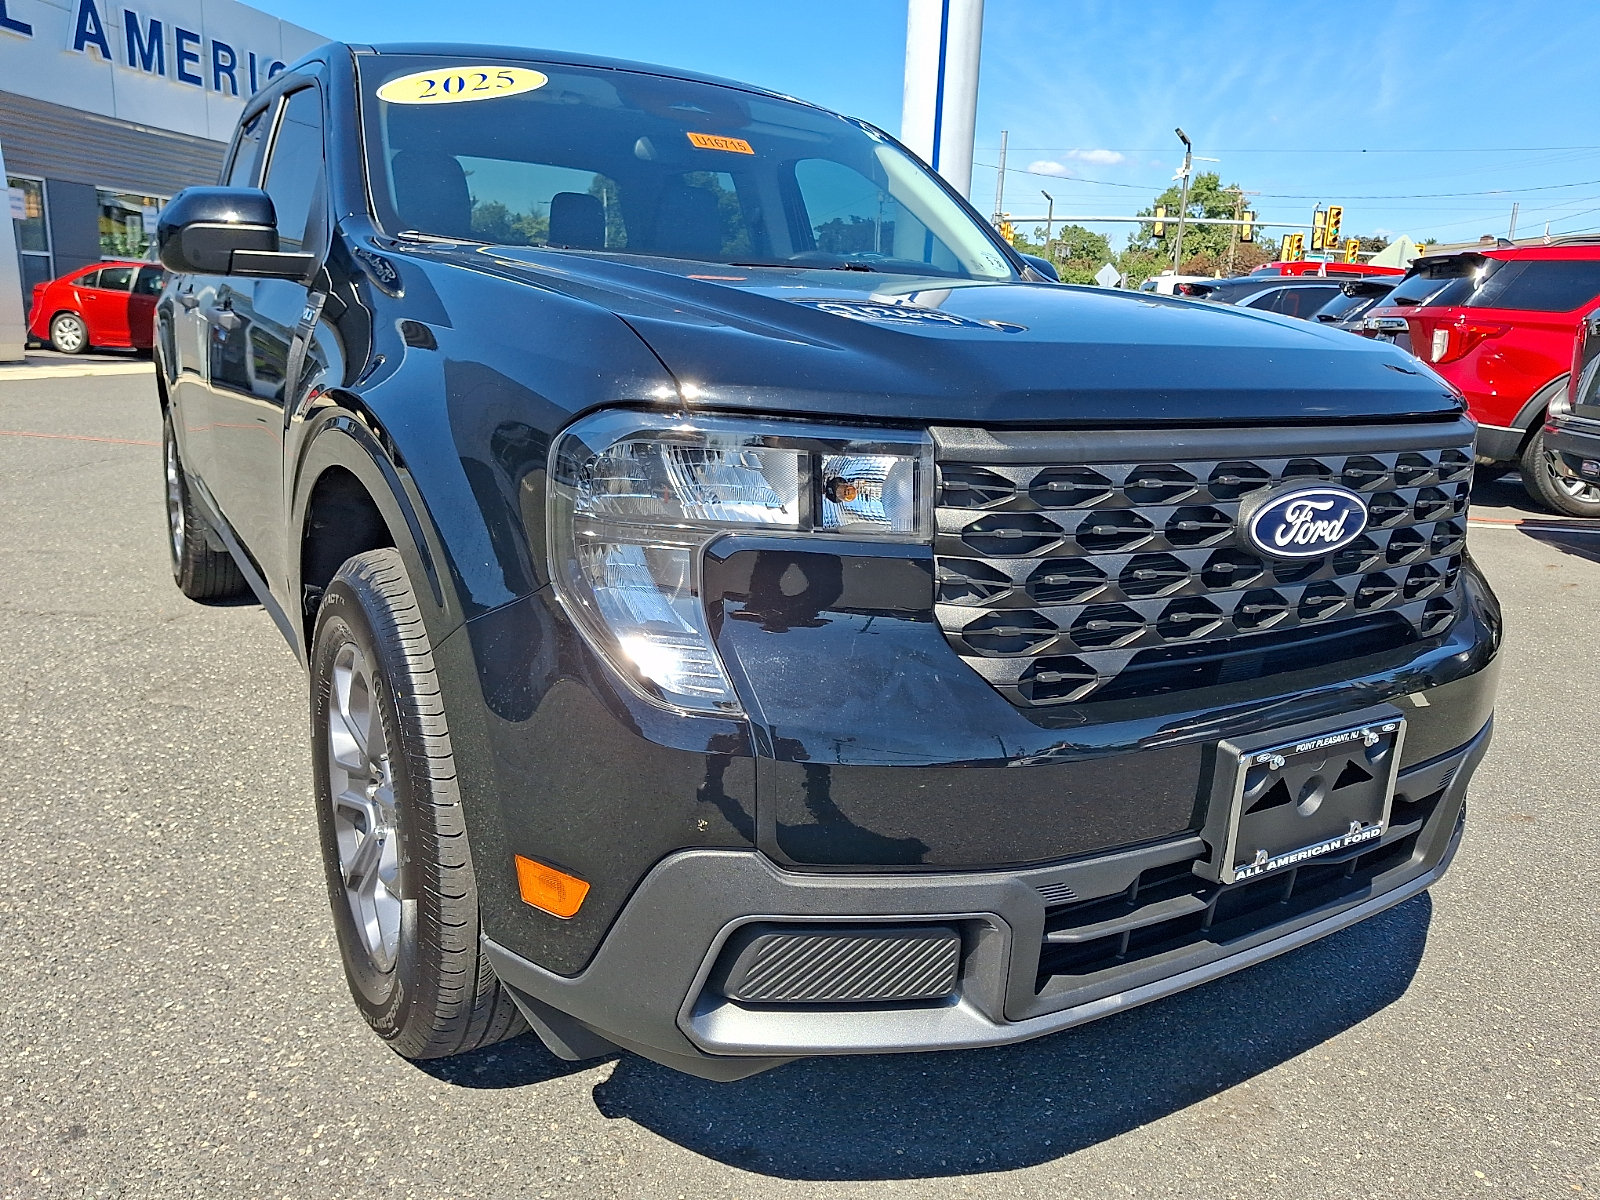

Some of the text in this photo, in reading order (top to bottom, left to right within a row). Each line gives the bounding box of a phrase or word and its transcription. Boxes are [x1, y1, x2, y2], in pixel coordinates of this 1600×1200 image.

[416, 70, 515, 98] 2025
[695, 134, 747, 151] U16715
[1274, 500, 1350, 547] Ford
[1295, 741, 1316, 752] POINT
[1350, 731, 1360, 740] NJ
[1235, 828, 1381, 881] ALL AMERICAN FORD
